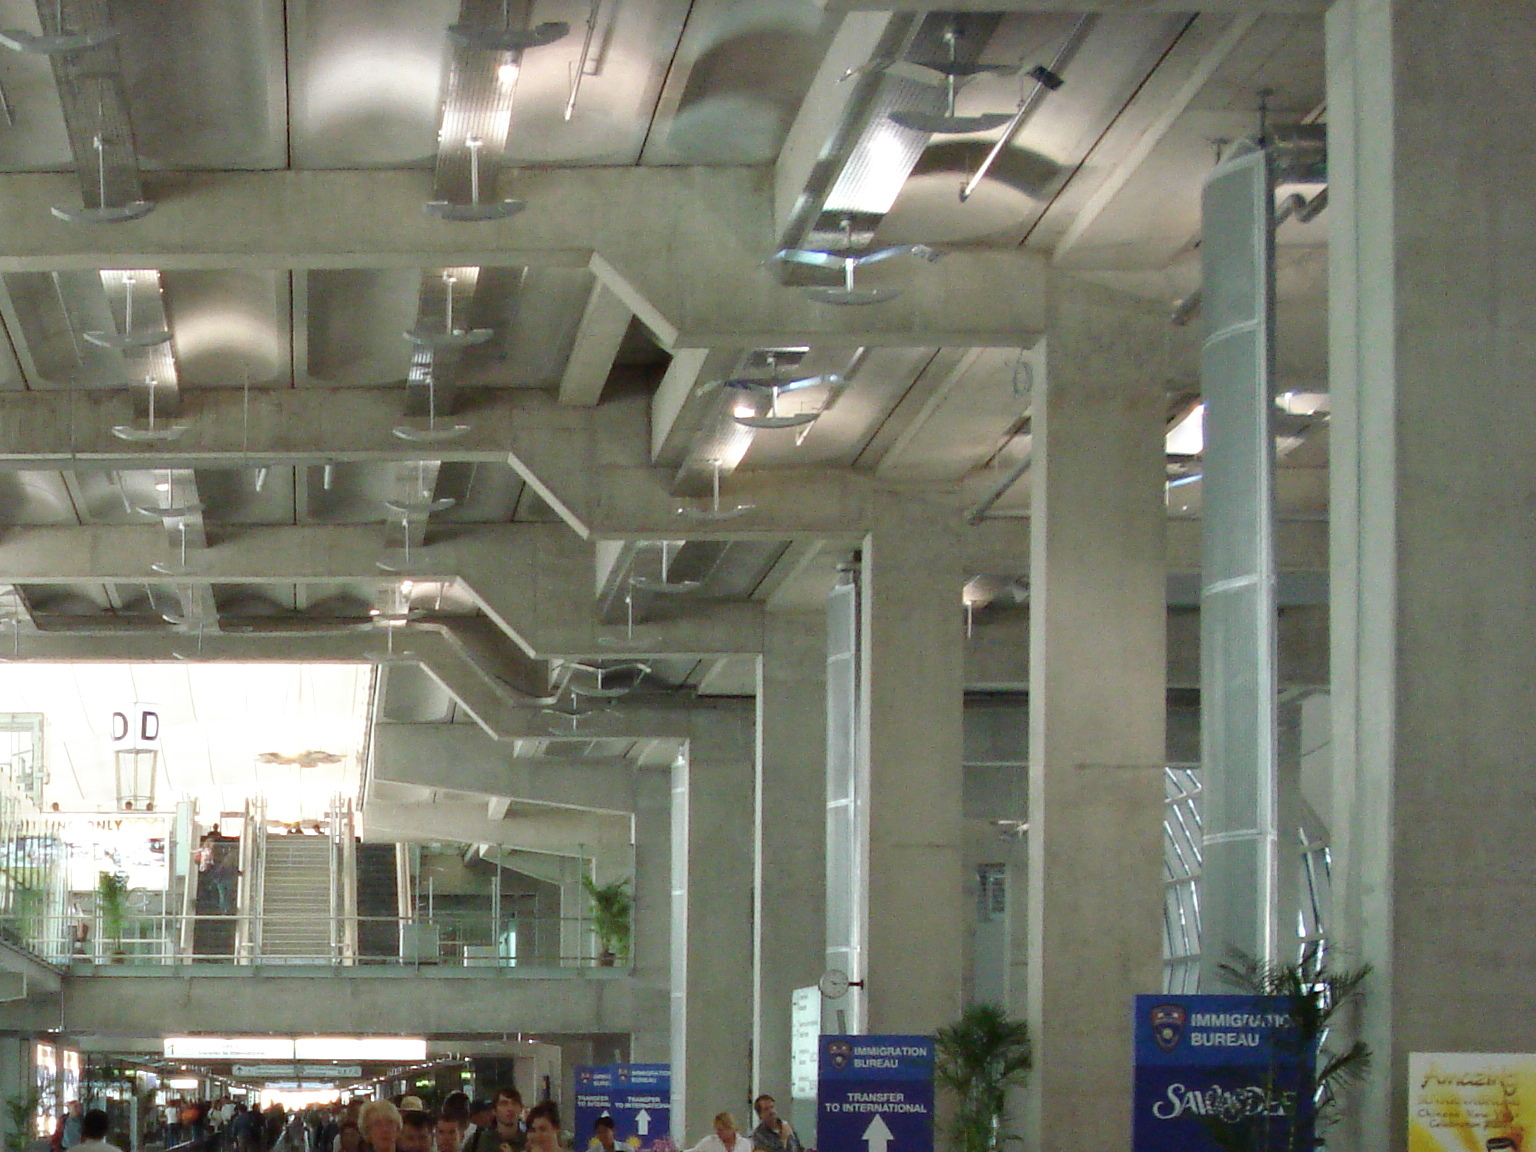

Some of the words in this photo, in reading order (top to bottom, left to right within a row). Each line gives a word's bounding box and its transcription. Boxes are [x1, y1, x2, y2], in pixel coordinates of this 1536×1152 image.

[112, 711, 128, 741] D
[141, 711, 159, 741] D
[1191, 1033, 1260, 1046] BUREAU
[854, 1046, 927, 1056] IMMIGRATION
[854, 1058, 899, 1068] BUREAU
[847, 1093, 904, 1102] TRANSFER
[825, 1103, 840, 1112] TO
[842, 1103, 927, 1113] INTERNATIONAL
